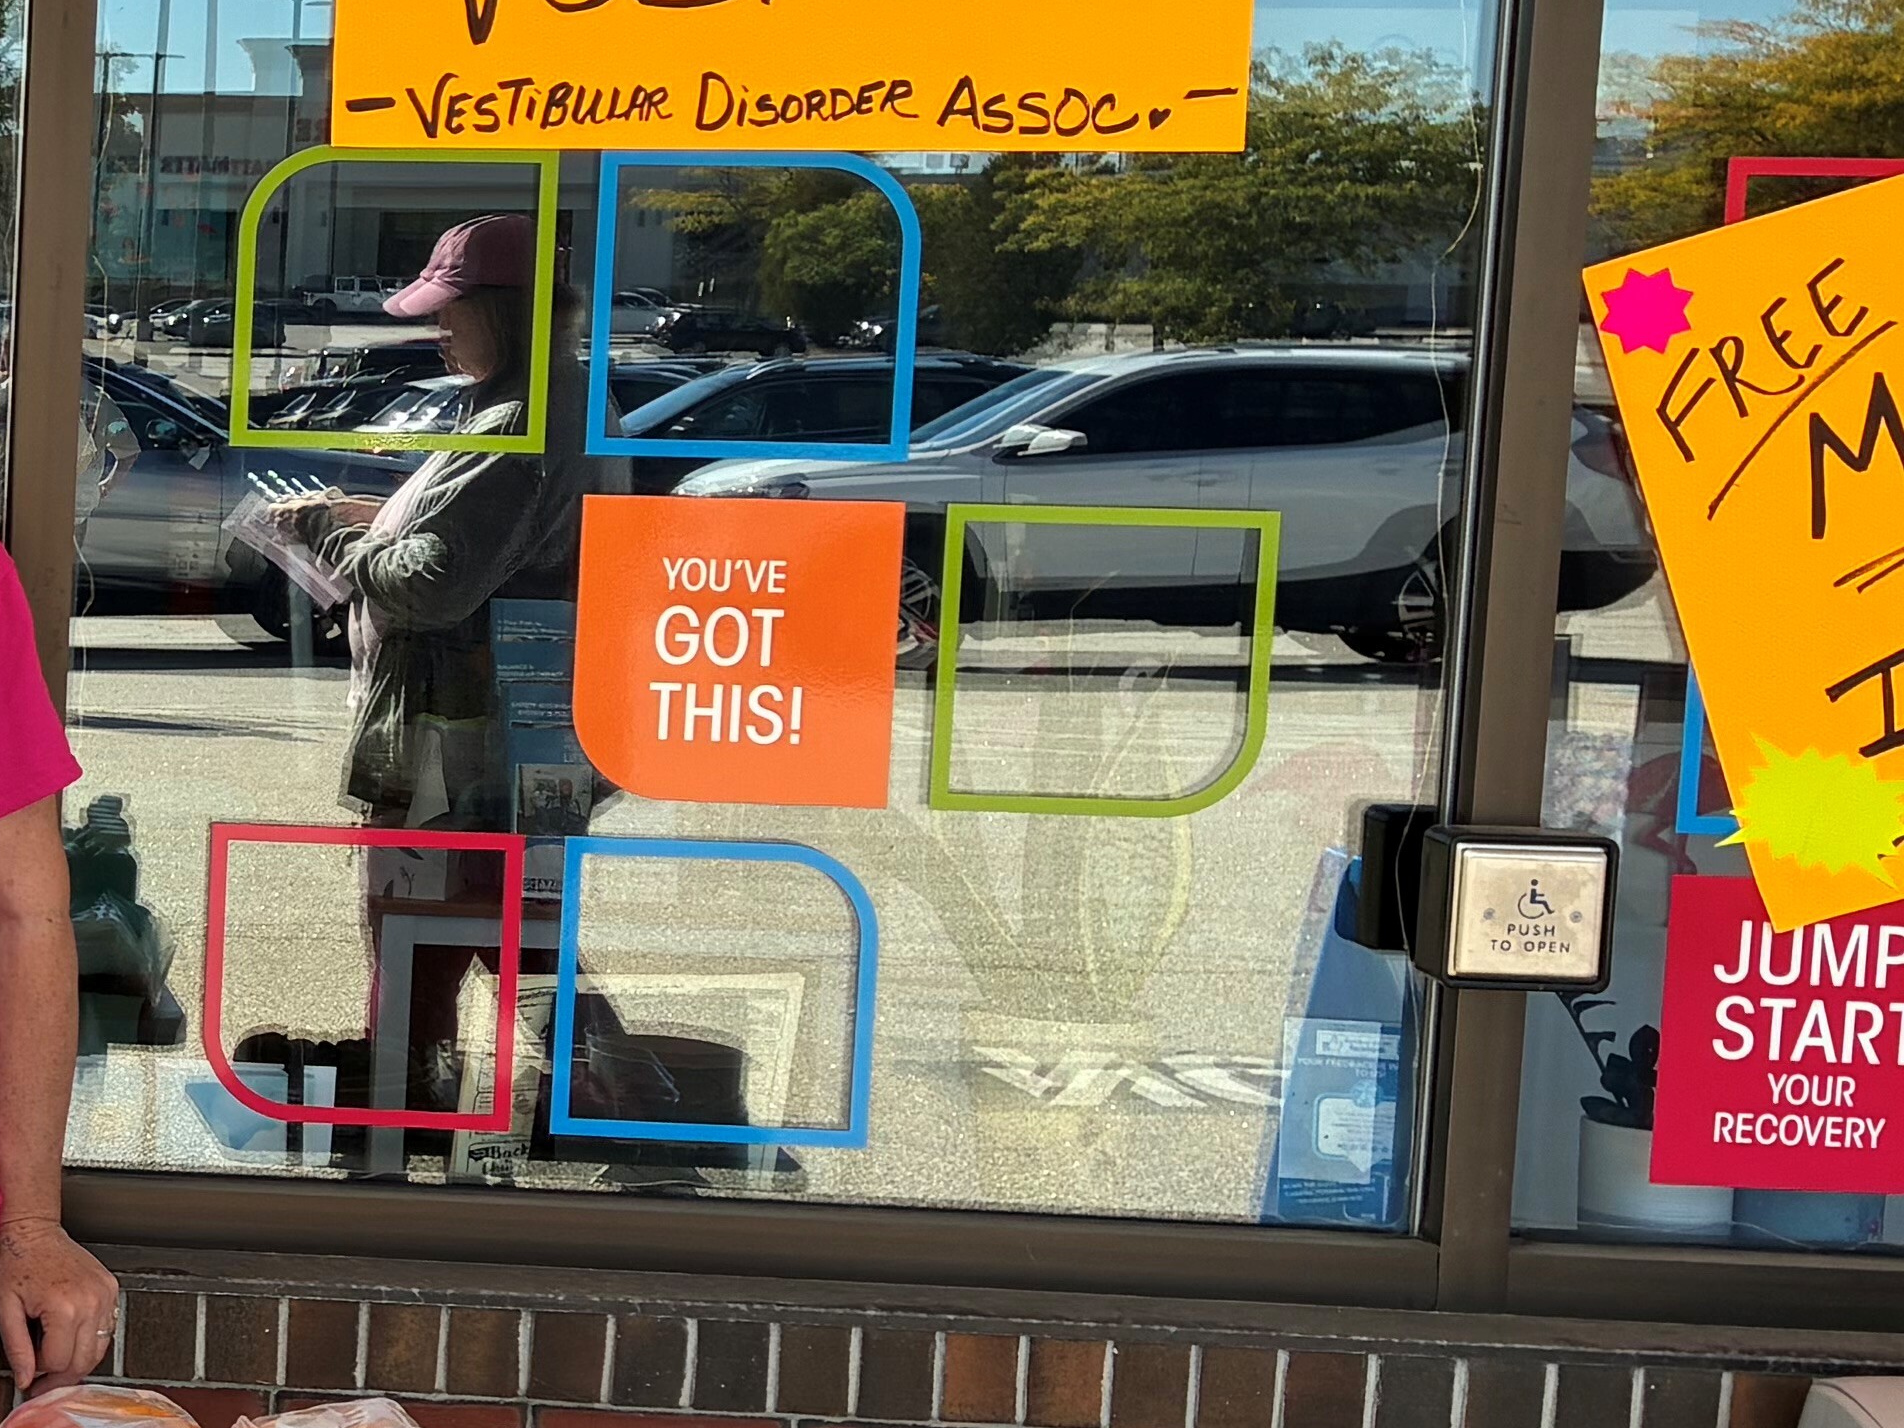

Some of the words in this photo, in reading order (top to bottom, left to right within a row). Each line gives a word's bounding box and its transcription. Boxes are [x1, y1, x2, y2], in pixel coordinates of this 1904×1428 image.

[404, 71, 672, 141] VESTIBULAR
[697, 71, 921, 134] DISORDER
[1655, 257, 1869, 464] FREE
[662, 556, 788, 594] YOU'VE
[654, 604, 785, 667] GOT
[649, 681, 803, 745] THIS!
[1490, 939, 1512, 952] TO
[1523, 940, 1571, 954] OPEN
[1507, 922, 1556, 937] PUSH
[1713, 919, 1904, 989] JUMP
[1767, 1072, 1857, 1108] YOUR
[1713, 1111, 1886, 1149] RECOVERY
